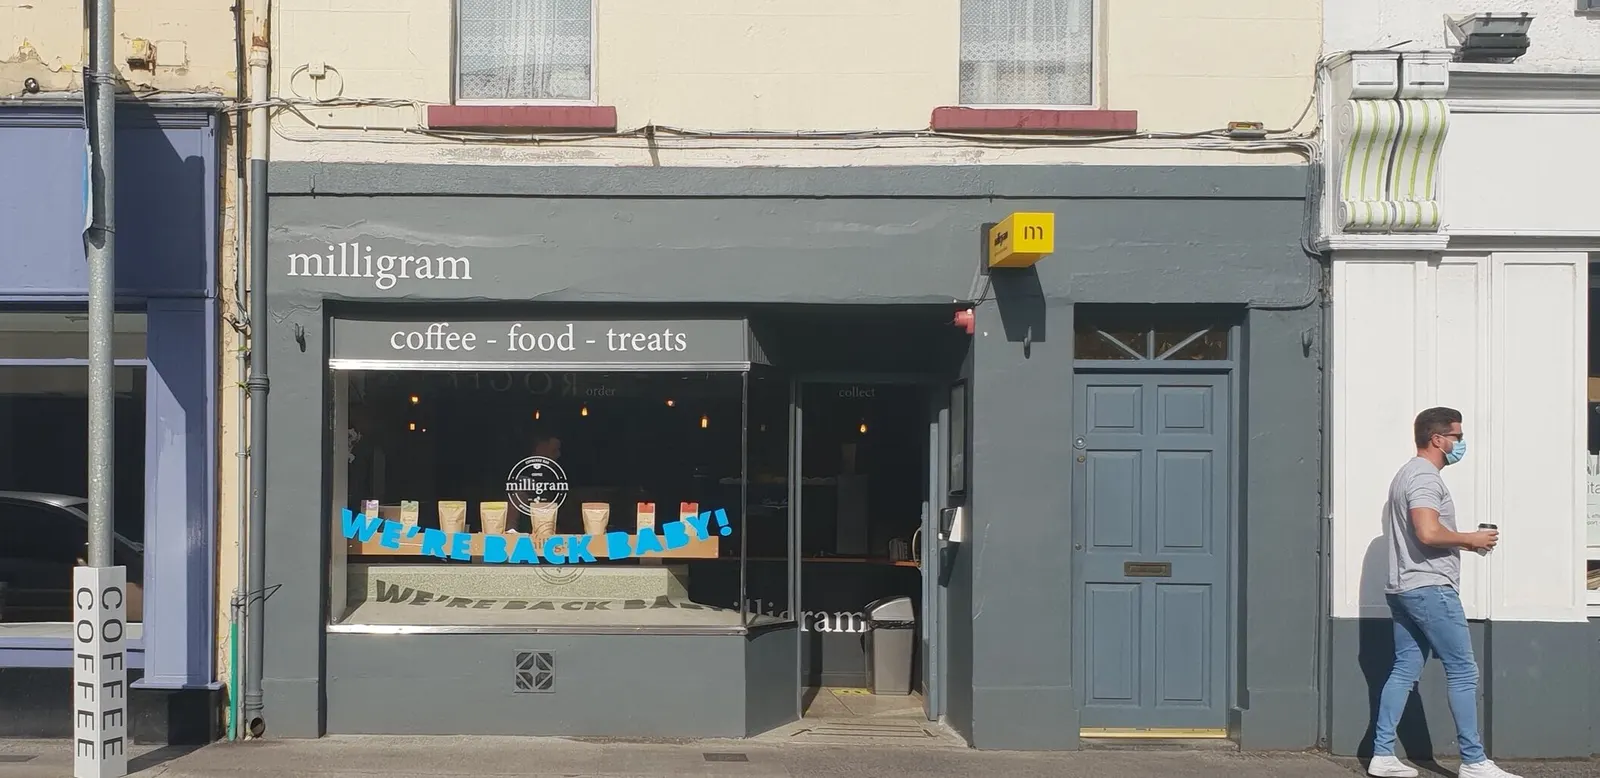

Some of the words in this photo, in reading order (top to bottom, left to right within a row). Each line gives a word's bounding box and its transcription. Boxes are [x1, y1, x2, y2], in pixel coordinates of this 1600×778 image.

[287, 242, 473, 290] milligram
[390, 323, 476, 350] coffee
[508, 323, 575, 351] food
[606, 327, 687, 351] treats
[585, 385, 616, 396] order
[838, 386, 876, 397] collect
[506, 479, 569, 494] milligram
[341, 508, 472, 561] WE'RE
[483, 534, 598, 564] BACK
[606, 508, 733, 560] BABY!
[502, 600, 612, 611] BACK
[77, 587, 94, 760] COFFEE
[102, 586, 123, 760] COFFEE
